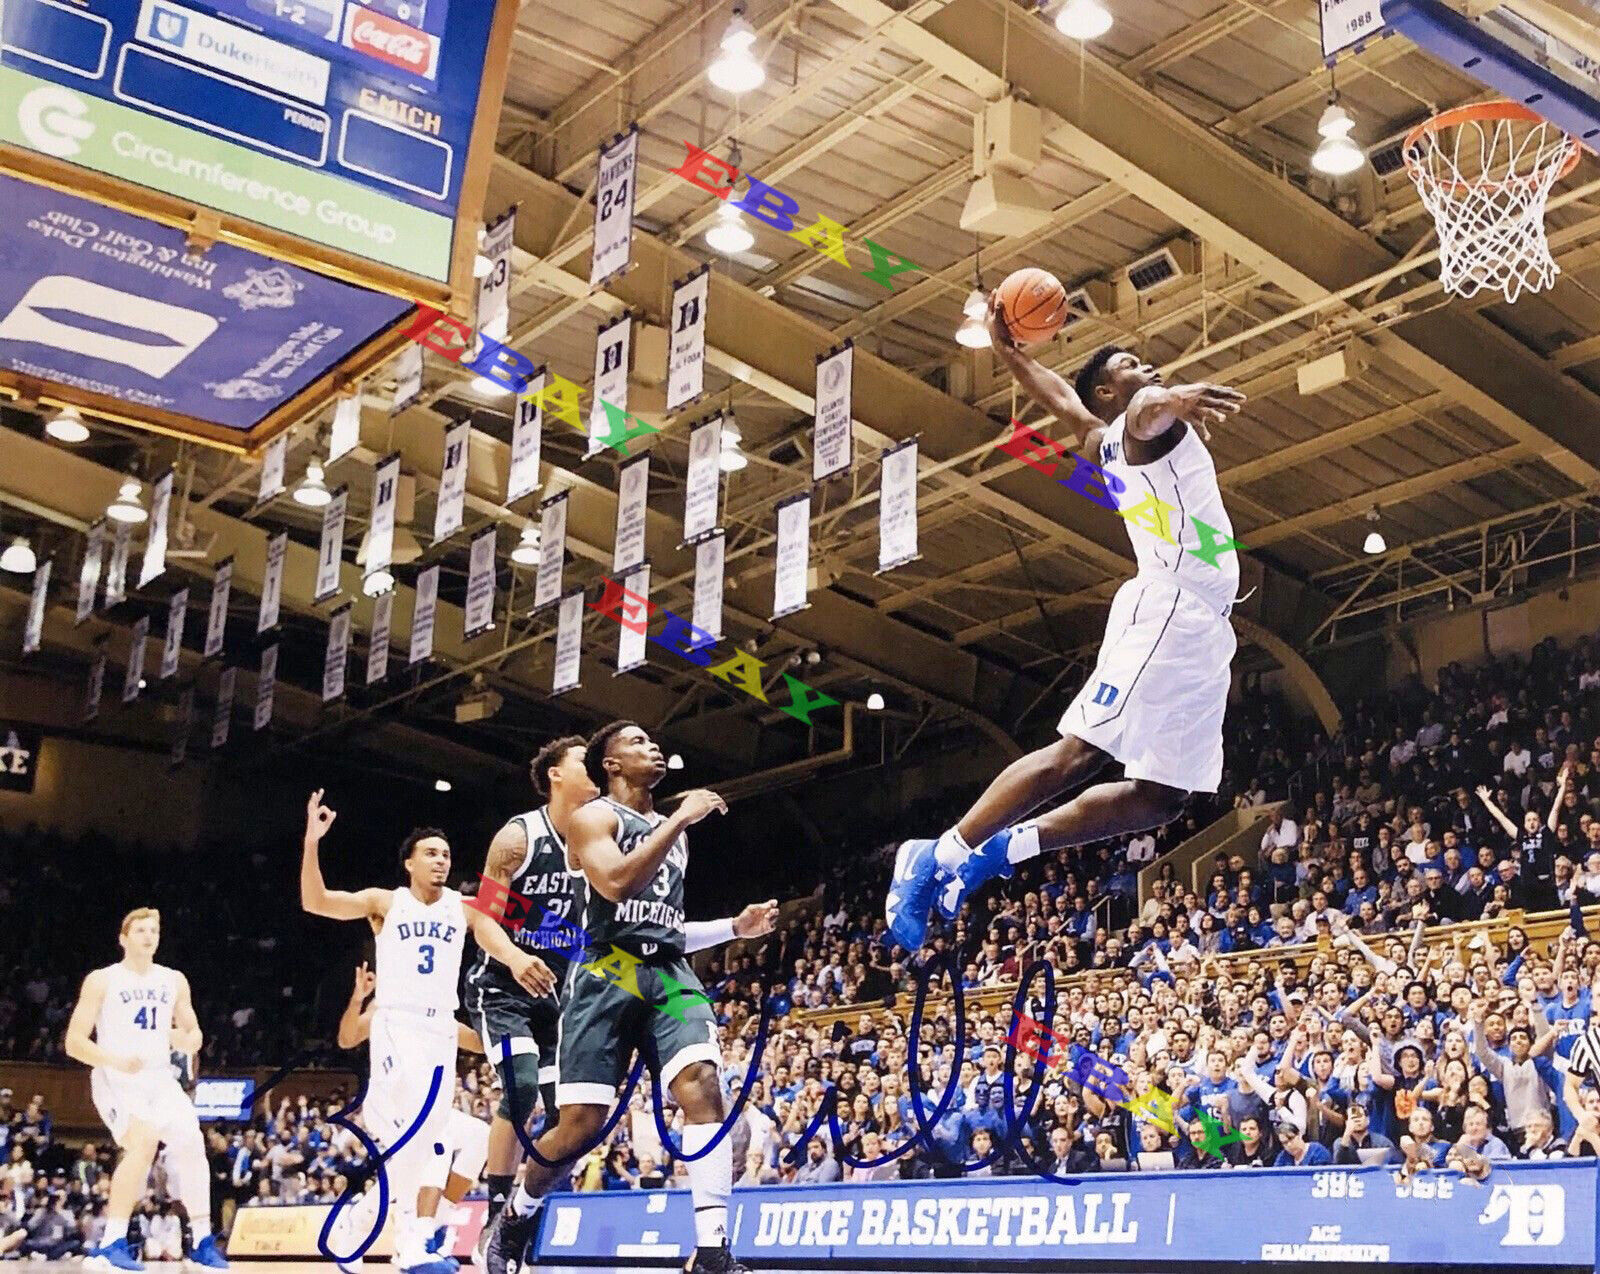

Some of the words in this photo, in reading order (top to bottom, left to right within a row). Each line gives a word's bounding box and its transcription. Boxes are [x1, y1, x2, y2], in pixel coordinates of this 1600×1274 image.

[1346, 11, 1372, 33] 1988
[358, 88, 442, 136] EMICH
[110, 131, 311, 217] Circumference
[315, 200, 397, 244] Group
[601, 179, 628, 222] 24
[521, 872, 575, 895] EAST
[652, 862, 671, 898] 3
[397, 921, 457, 943] DUKE
[417, 944, 435, 974] 3
[119, 988, 170, 1004] DUKE
[134, 1006, 157, 1030] 41
[753, 1199, 854, 1247] DUKE
[856, 1192, 1138, 1247] BASKETBALL
